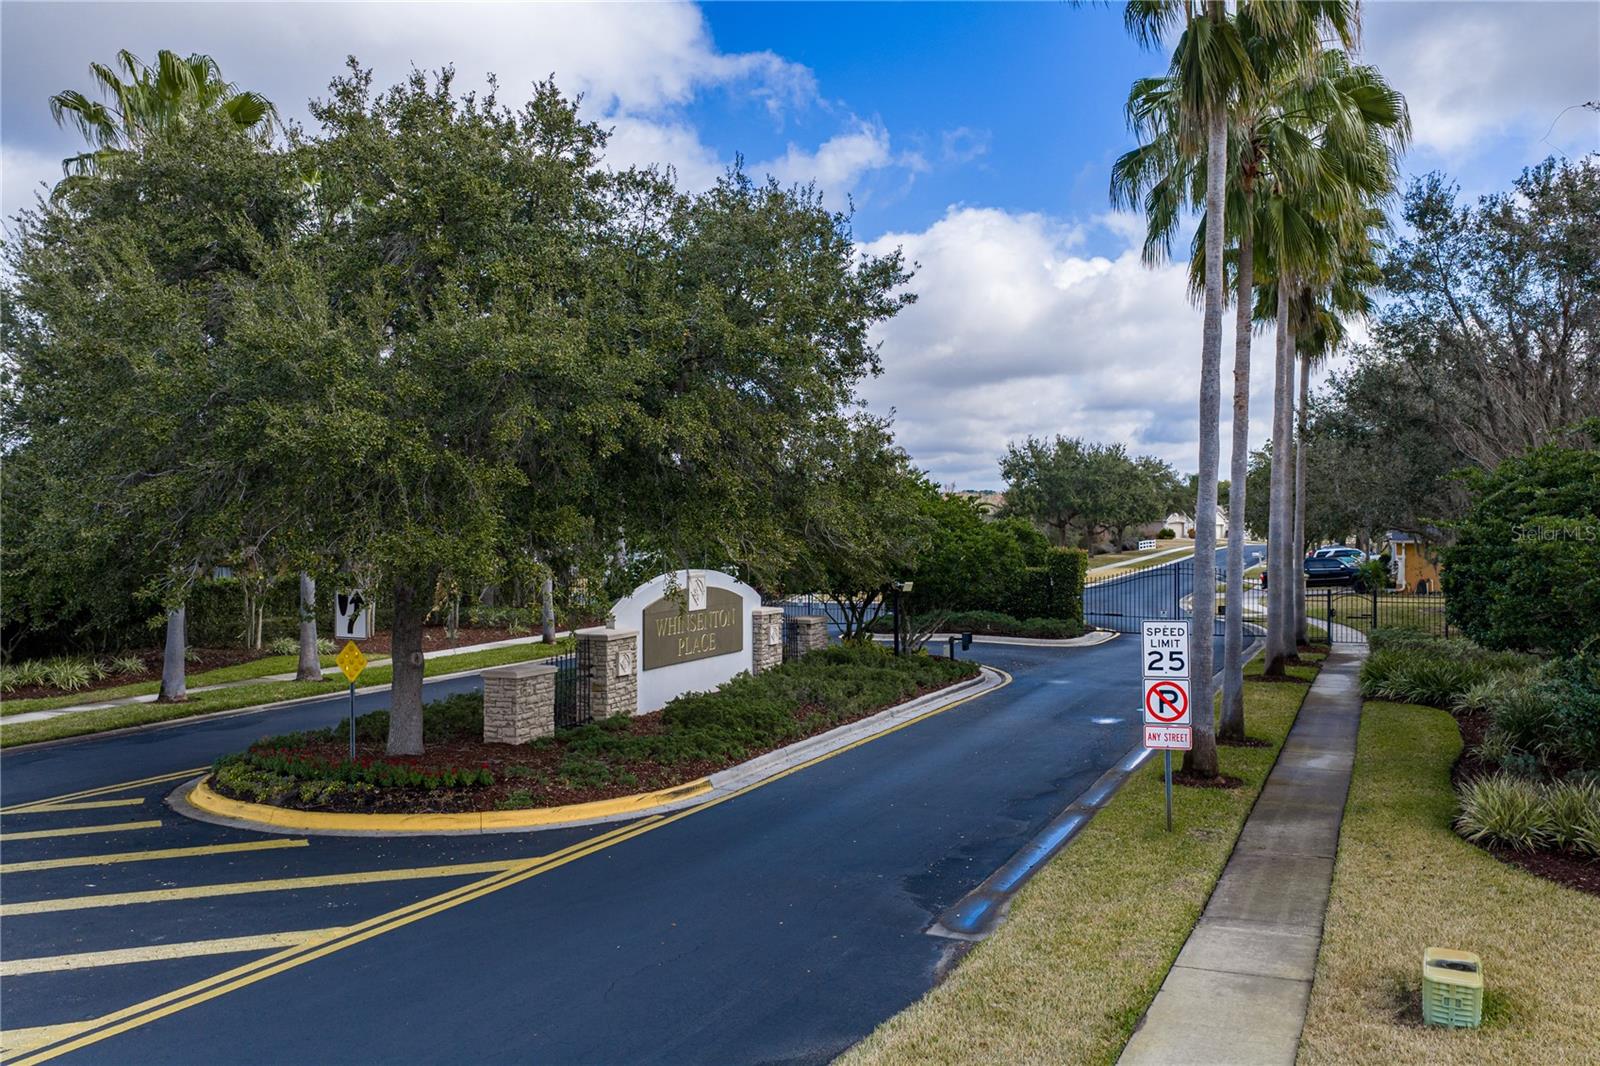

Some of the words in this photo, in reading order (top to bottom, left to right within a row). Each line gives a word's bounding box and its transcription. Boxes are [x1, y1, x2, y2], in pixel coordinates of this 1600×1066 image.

[656, 608, 736, 637] WHINSENTON
[1146, 627, 1185, 637] SPEED
[678, 633, 717, 657] PLACE
[1150, 639, 1180, 648] LIMIT
[1147, 651, 1185, 671] 25
[1158, 689, 1179, 714] P
[1147, 732, 1162, 741] ANY
[1164, 732, 1188, 743] STREET
